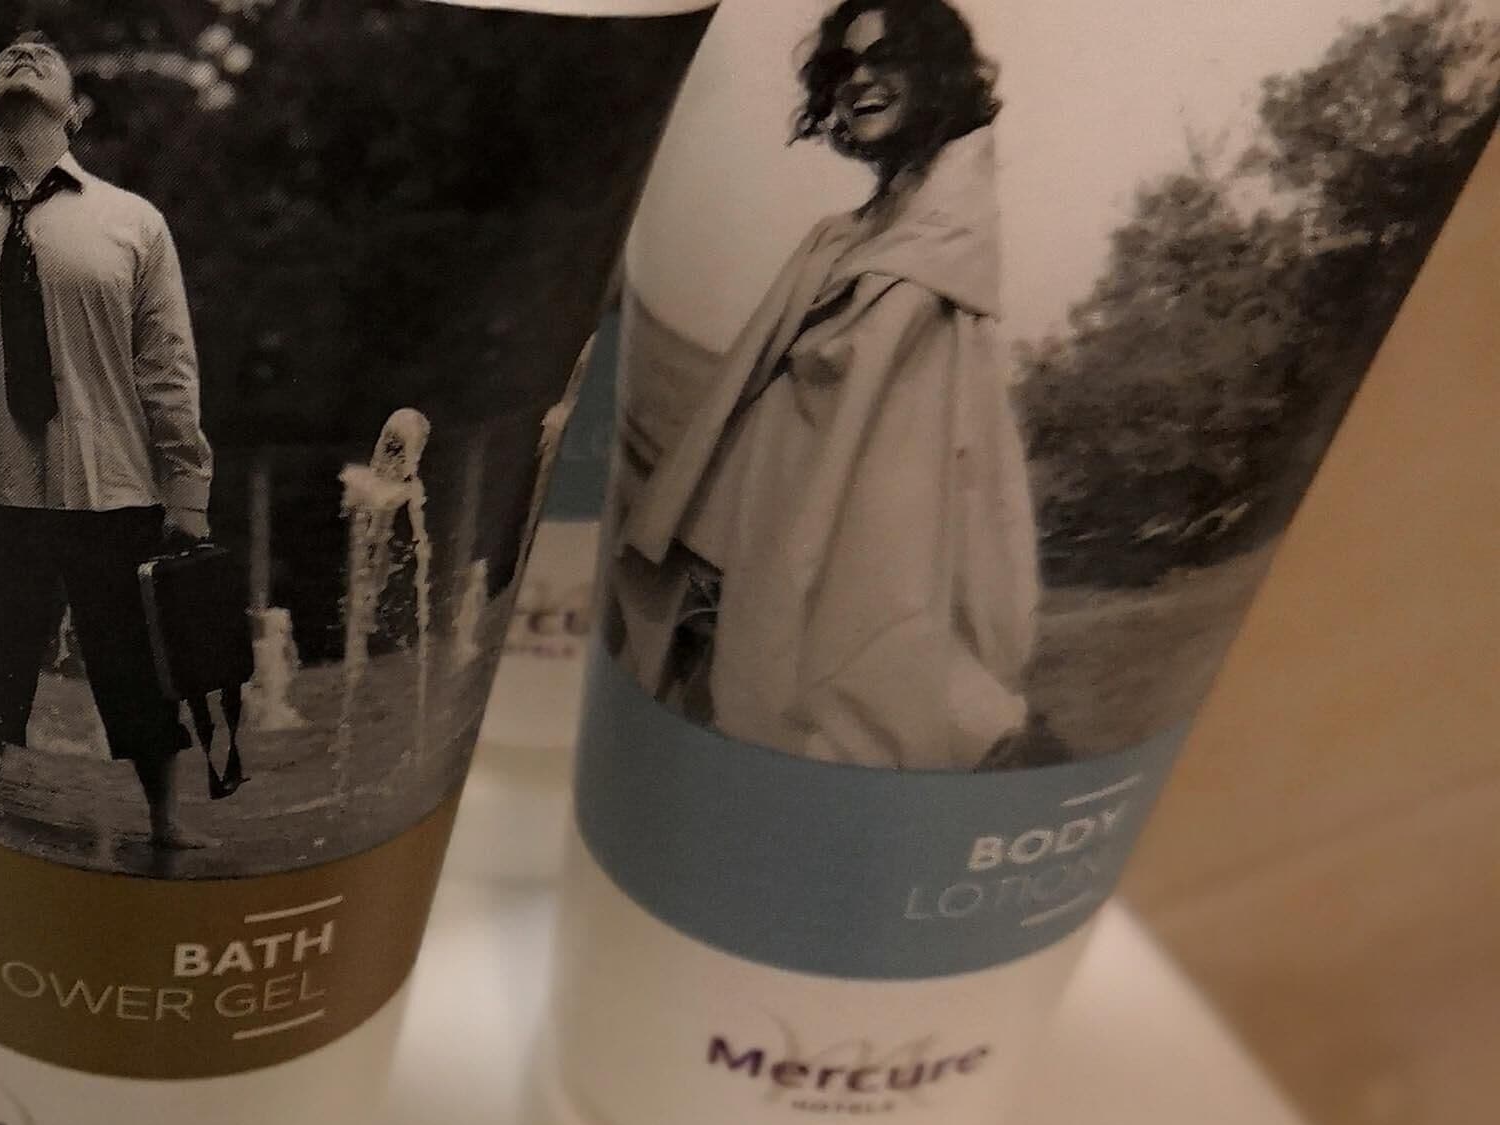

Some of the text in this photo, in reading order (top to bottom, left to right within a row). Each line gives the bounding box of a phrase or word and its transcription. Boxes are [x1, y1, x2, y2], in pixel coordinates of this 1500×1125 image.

[966, 806, 1130, 873] BODY
[174, 920, 333, 978] BATH
[214, 970, 326, 1019] GEL
[706, 1034, 991, 1094] Mercure
